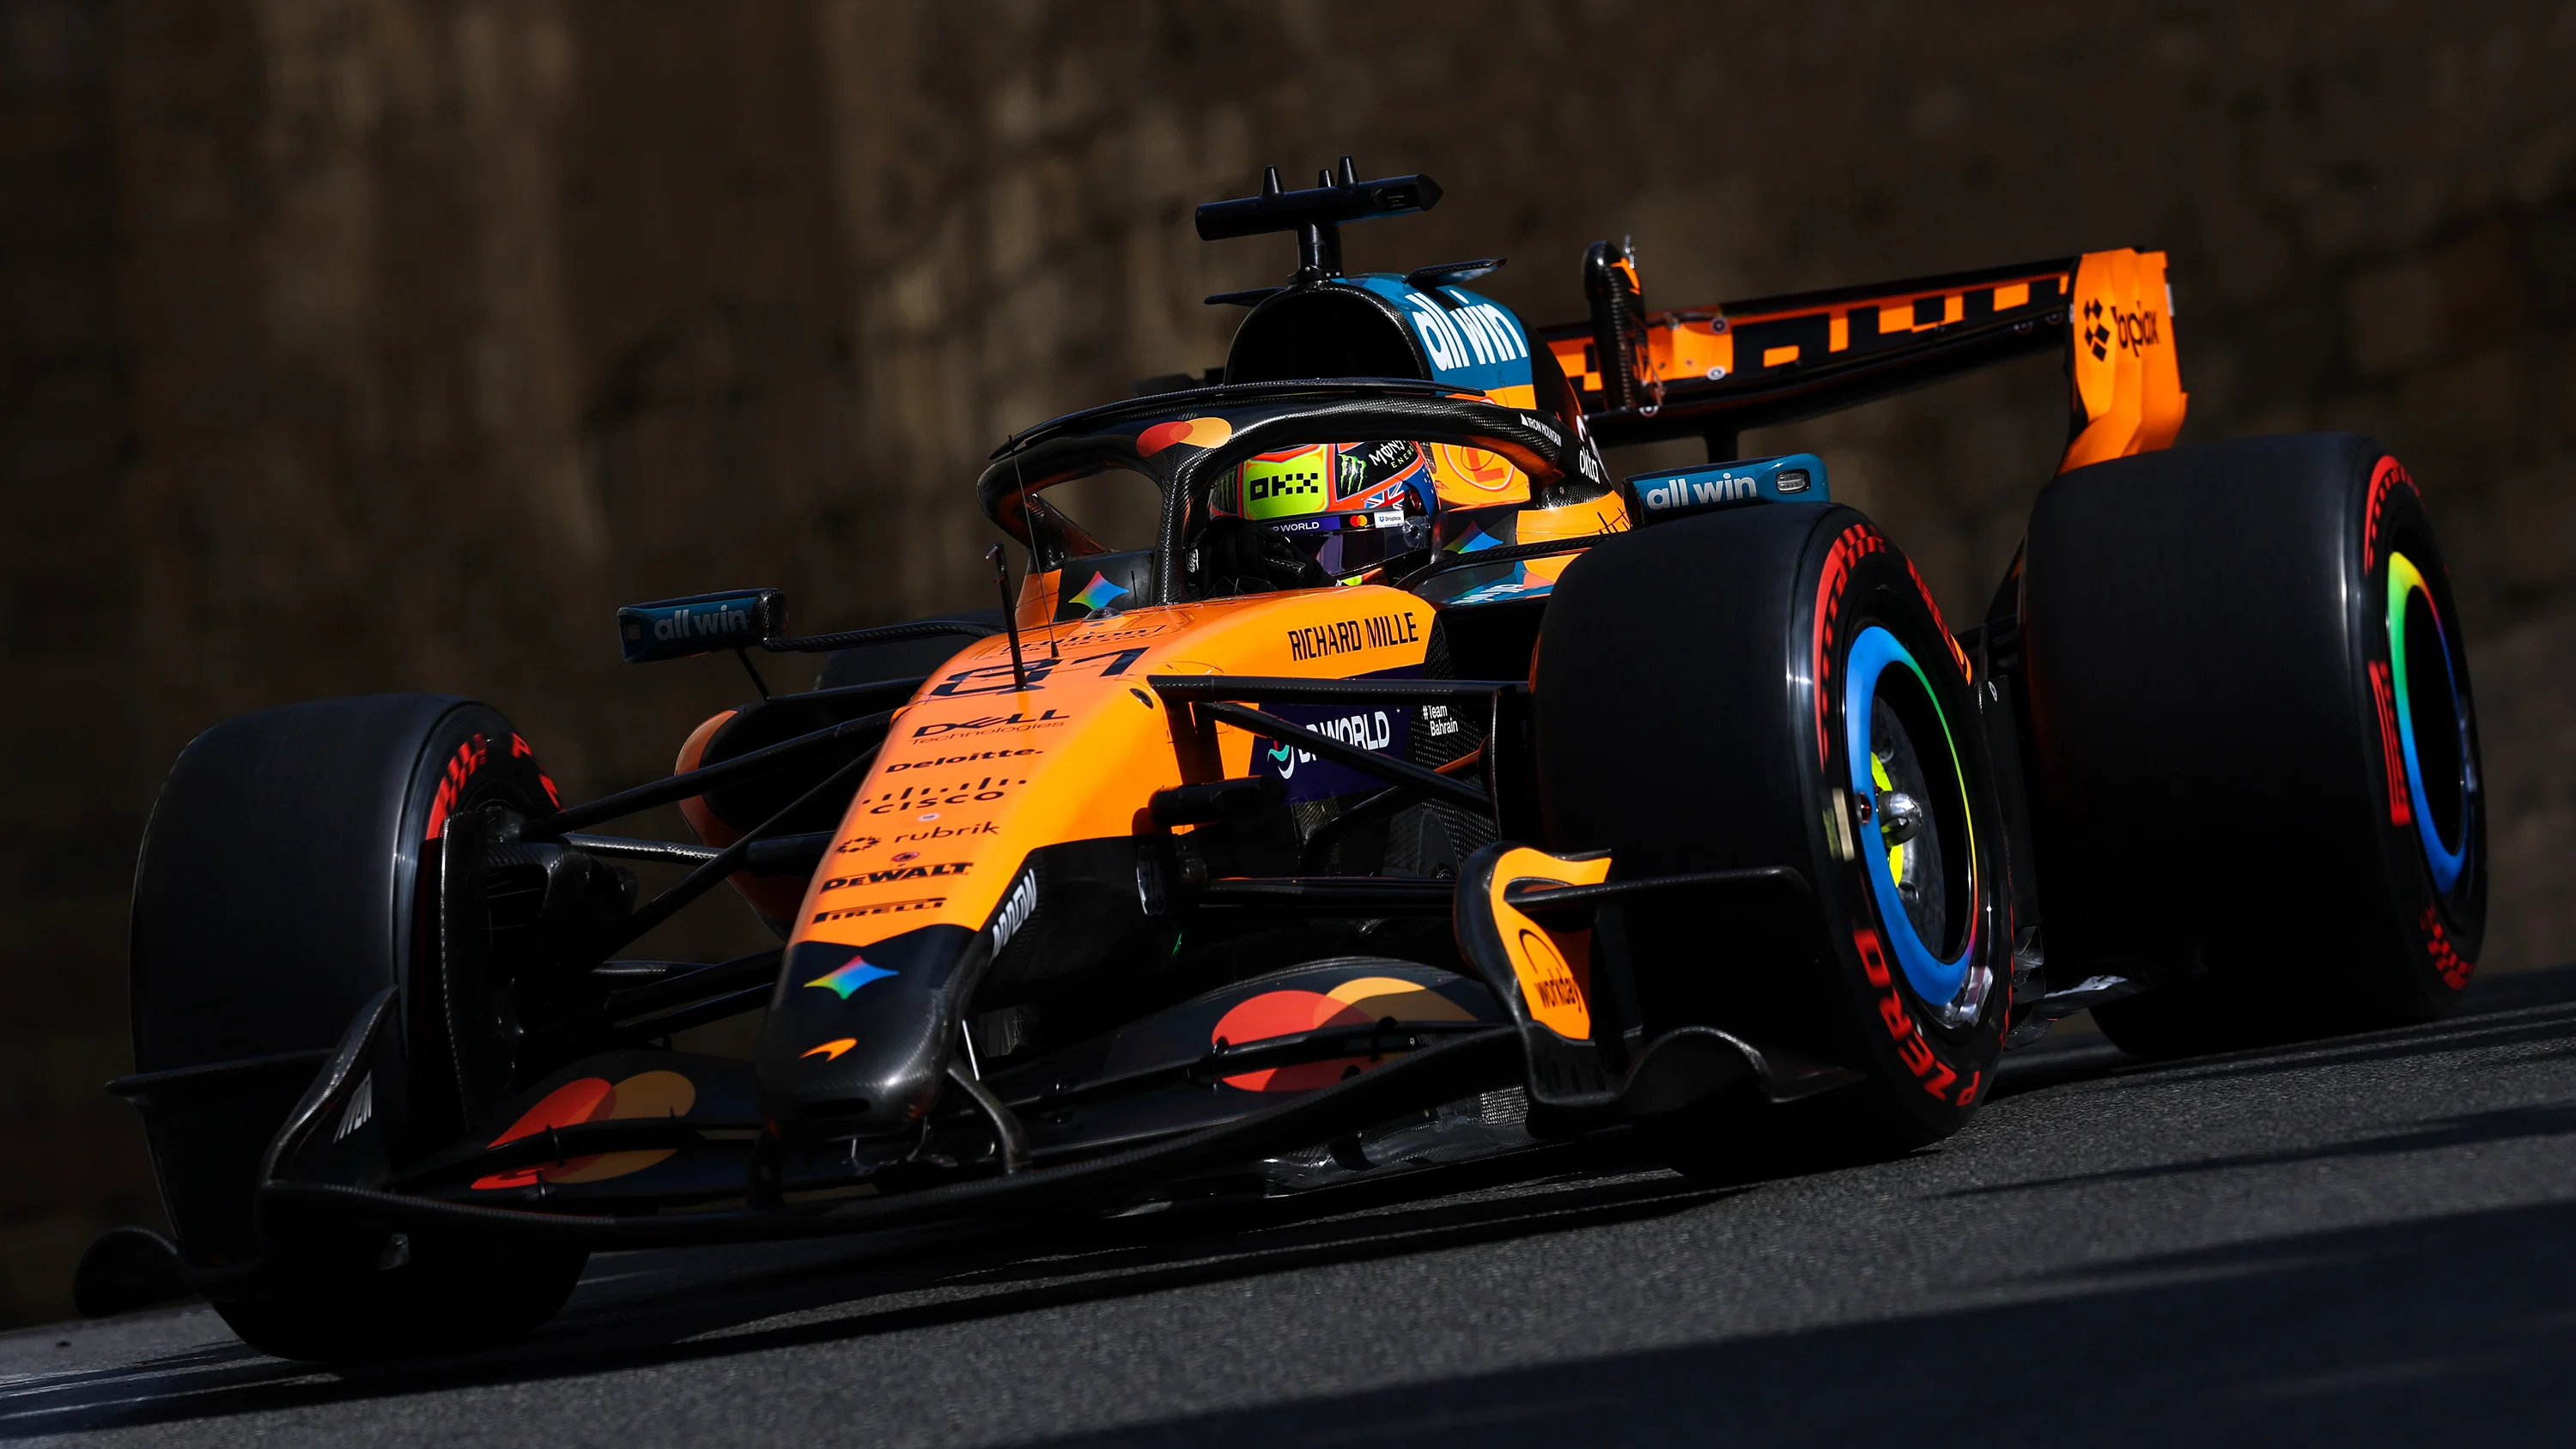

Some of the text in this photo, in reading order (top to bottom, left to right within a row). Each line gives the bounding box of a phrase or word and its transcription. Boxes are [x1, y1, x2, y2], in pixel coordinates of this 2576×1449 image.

[1405, 289, 1528, 371] all win
[1579, 446, 1600, 484] okta
[1250, 473, 1318, 501] OKX
[1646, 473, 1757, 511] all win
[1280, 522, 1320, 532] WORLD
[654, 604, 749, 640] all win
[1287, 612, 1419, 661] RICHARD MILLE
[912, 709, 1070, 738] DELL
[1422, 705, 1448, 720] #Team
[1430, 716, 1459, 737] Bahrain
[910, 721, 1064, 745] Technologies
[885, 749, 1044, 773] Deloitte.
[894, 822, 1000, 843] rubrik
[812, 897, 947, 925] PIRELLI
[1533, 967, 1582, 1014] workday
[1853, 926, 1958, 1101] ZERO
